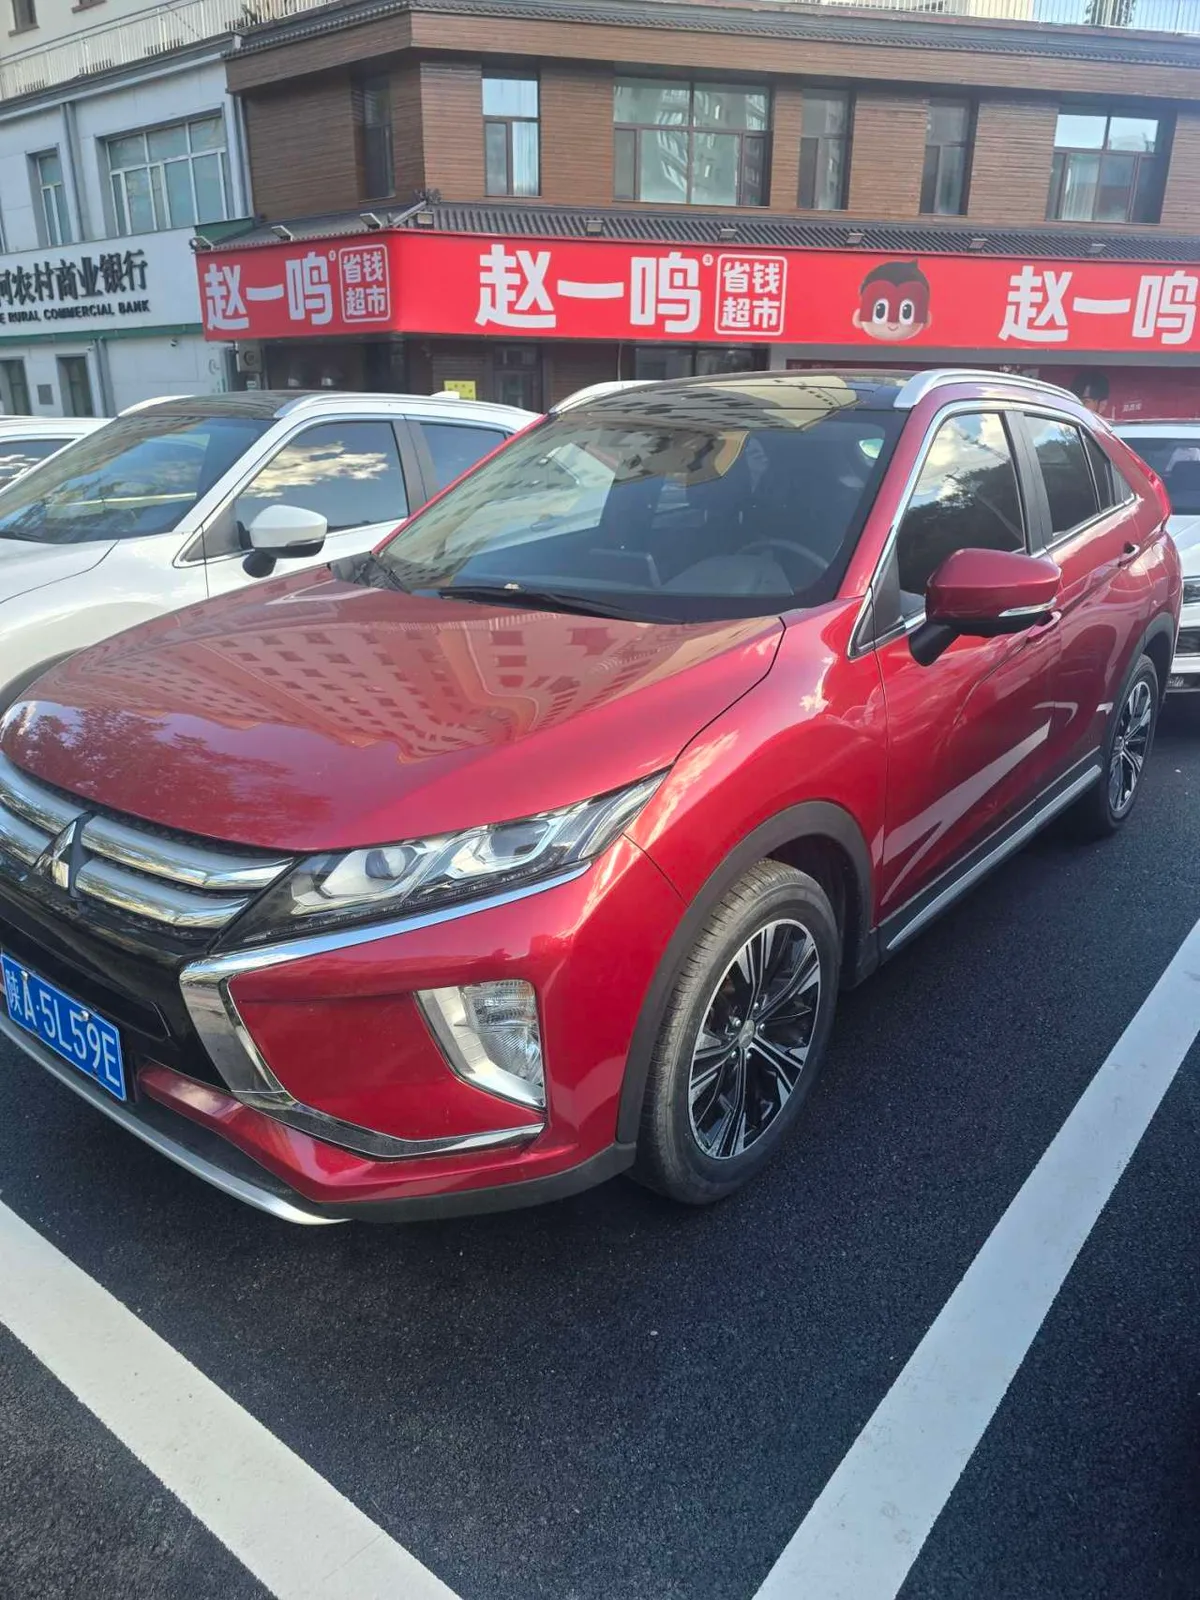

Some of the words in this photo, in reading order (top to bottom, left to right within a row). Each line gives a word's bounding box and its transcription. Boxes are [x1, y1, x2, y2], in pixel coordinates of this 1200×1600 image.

[343, 250, 384, 284] 省钱
[722, 261, 781, 294] 省钱
[204, 251, 333, 331] 赵一鸣
[345, 284, 387, 317] 超市
[475, 243, 702, 334] 赵一鸣
[997, 265, 1199, 345] 赵一鸣
[8, 310, 42, 323] RURAL
[43, 303, 115, 320] COMMERCIAL
[118, 300, 151, 314] BANK
[720, 296, 781, 329] 超市
